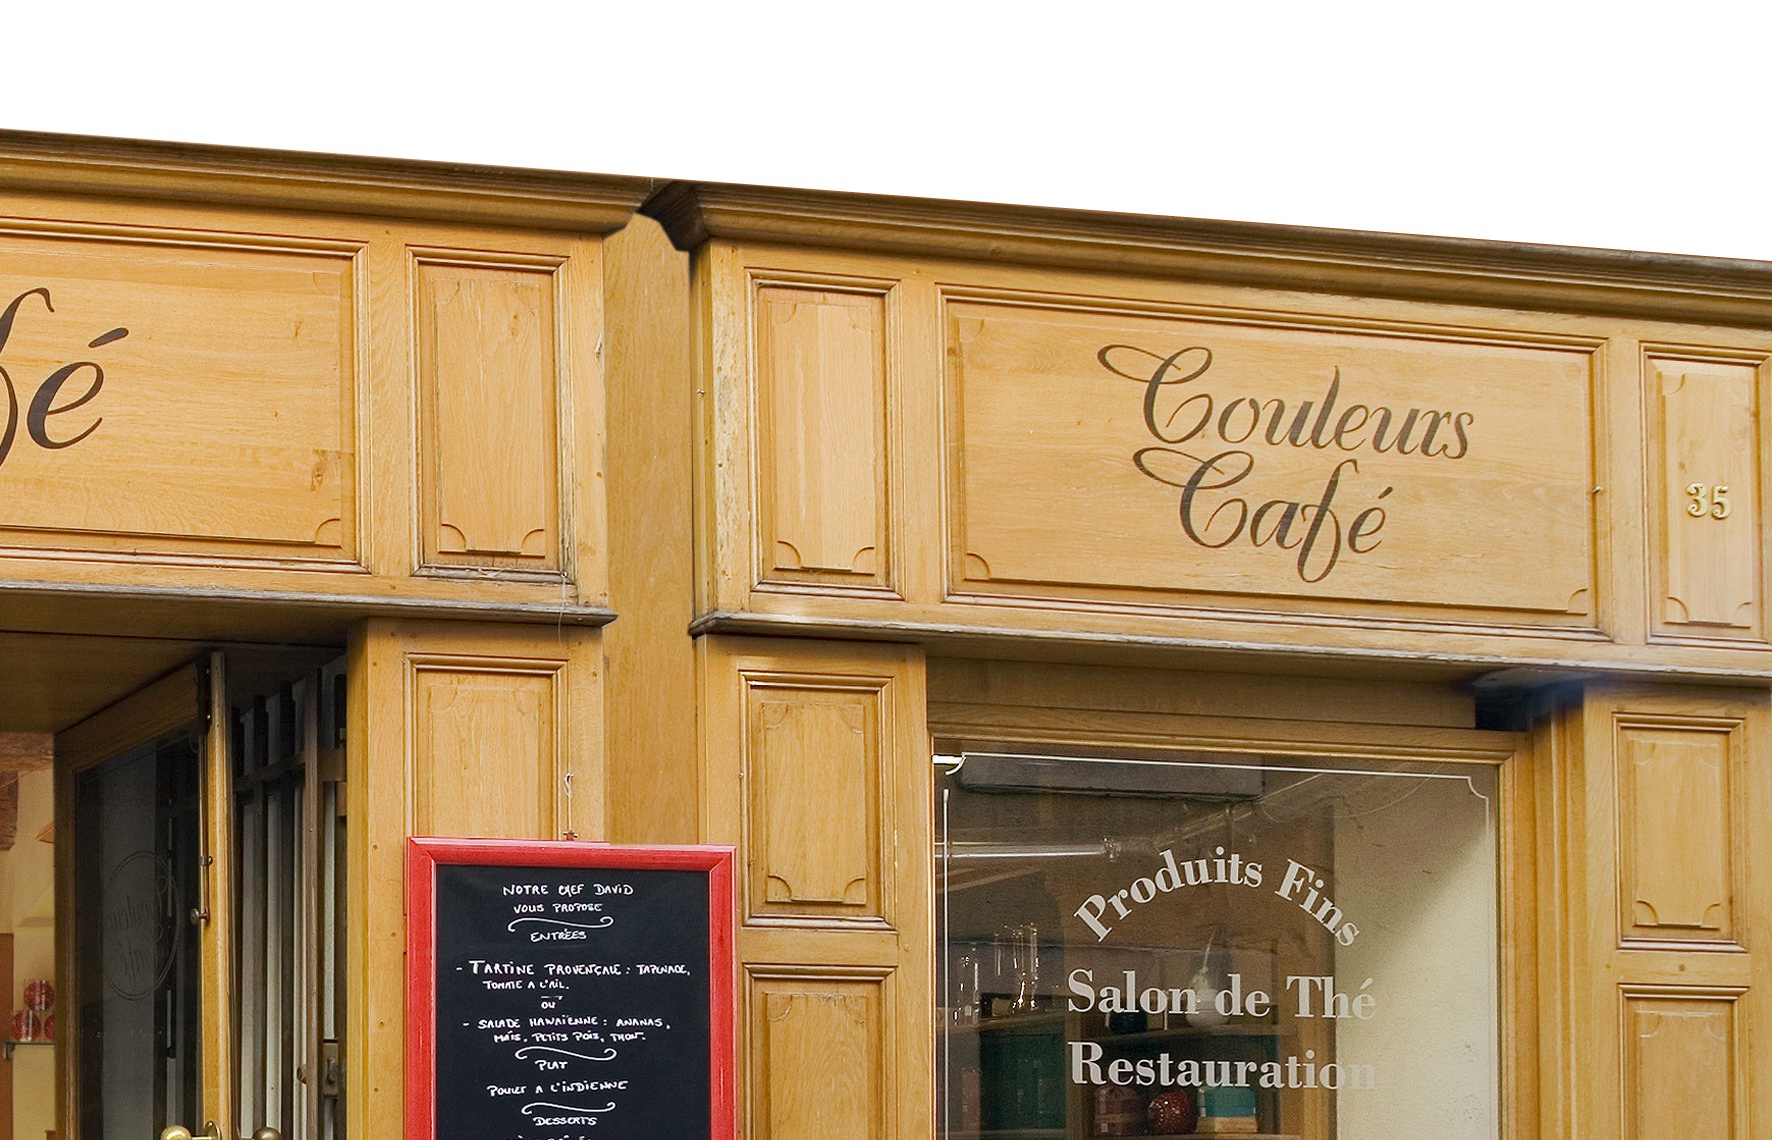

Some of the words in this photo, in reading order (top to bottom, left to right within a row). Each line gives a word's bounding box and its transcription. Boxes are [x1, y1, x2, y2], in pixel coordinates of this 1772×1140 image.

[1096, 343, 1474, 460] Couleurs
[1685, 482, 1730, 520] 35
[1132, 447, 1394, 584] Café
[503, 884, 549, 896] NOTRE
[558, 884, 585, 897] CHEF
[594, 884, 634, 896] DAVID
[1073, 846, 1263, 943] Produits
[1274, 858, 1360, 947] Fins
[513, 903, 544, 913] VOUS
[553, 903, 603, 913] PROPOSE
[469, 960, 535, 975] TARTINE
[483, 980, 523, 990] TOMME
[1068, 968, 1201, 1015] Salon
[1215, 974, 1271, 1017] de
[1286, 976, 1377, 1020] Thé
[541, 1001, 556, 1009] OU
[478, 1018, 521, 1029] SALADE
[535, 1060, 568, 1071] PLAT
[1068, 1040, 1377, 1091] Restauration
[533, 1116, 597, 1126] DESSERTS
